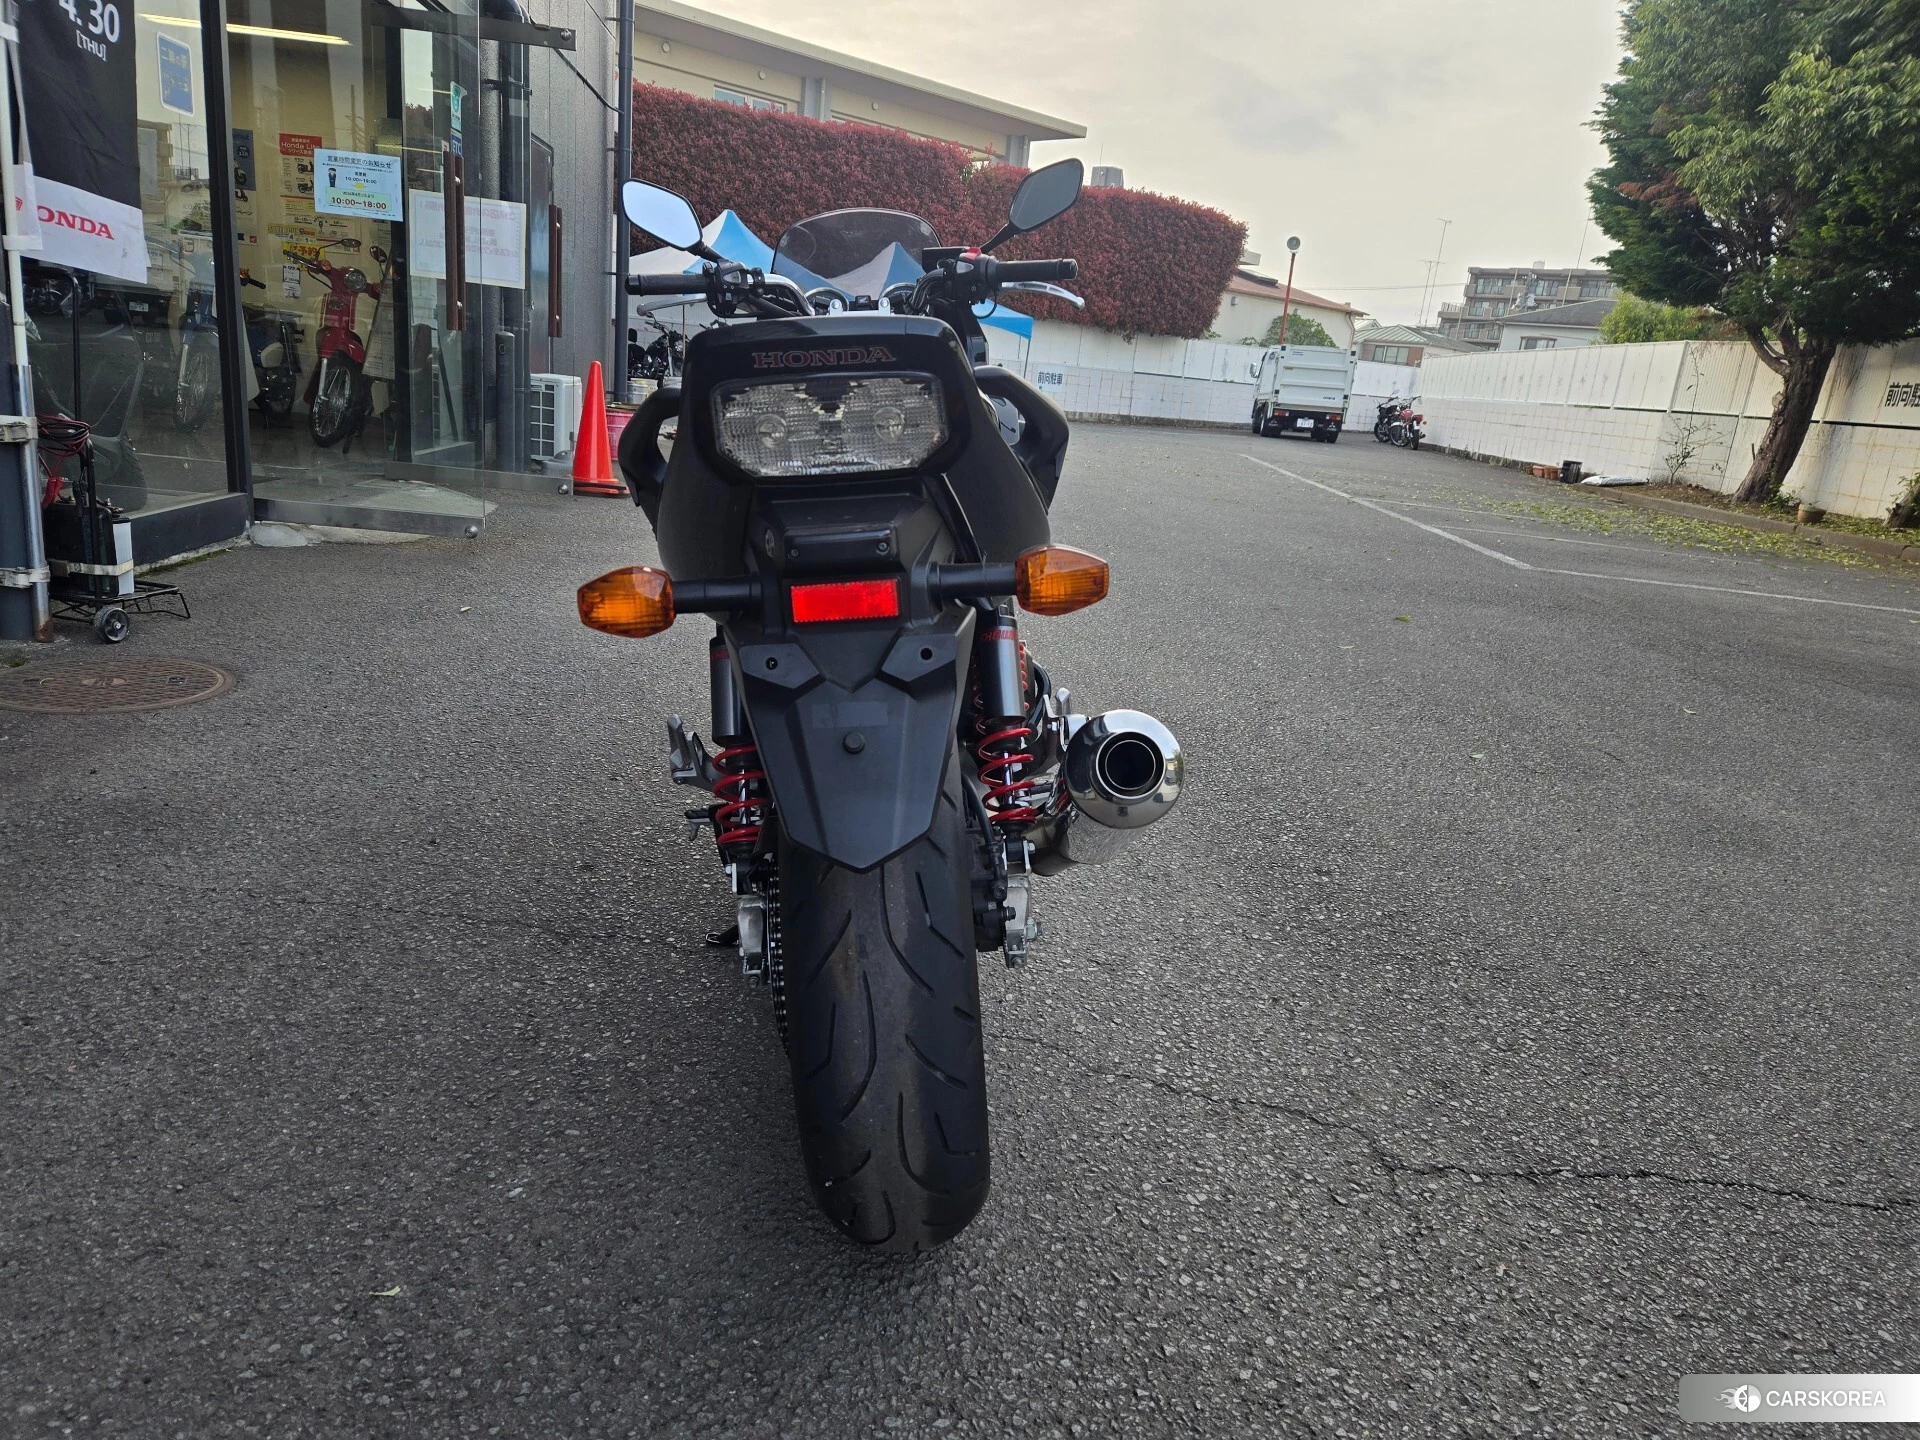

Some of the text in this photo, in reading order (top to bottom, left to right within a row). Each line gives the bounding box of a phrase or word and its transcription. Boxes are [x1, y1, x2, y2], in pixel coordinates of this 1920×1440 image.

[59, 0, 120, 43] 4.30
[37, 205, 115, 240] ONDA
[752, 346, 897, 368] HONDA
[1037, 371, 1063, 385] 前向駐車
